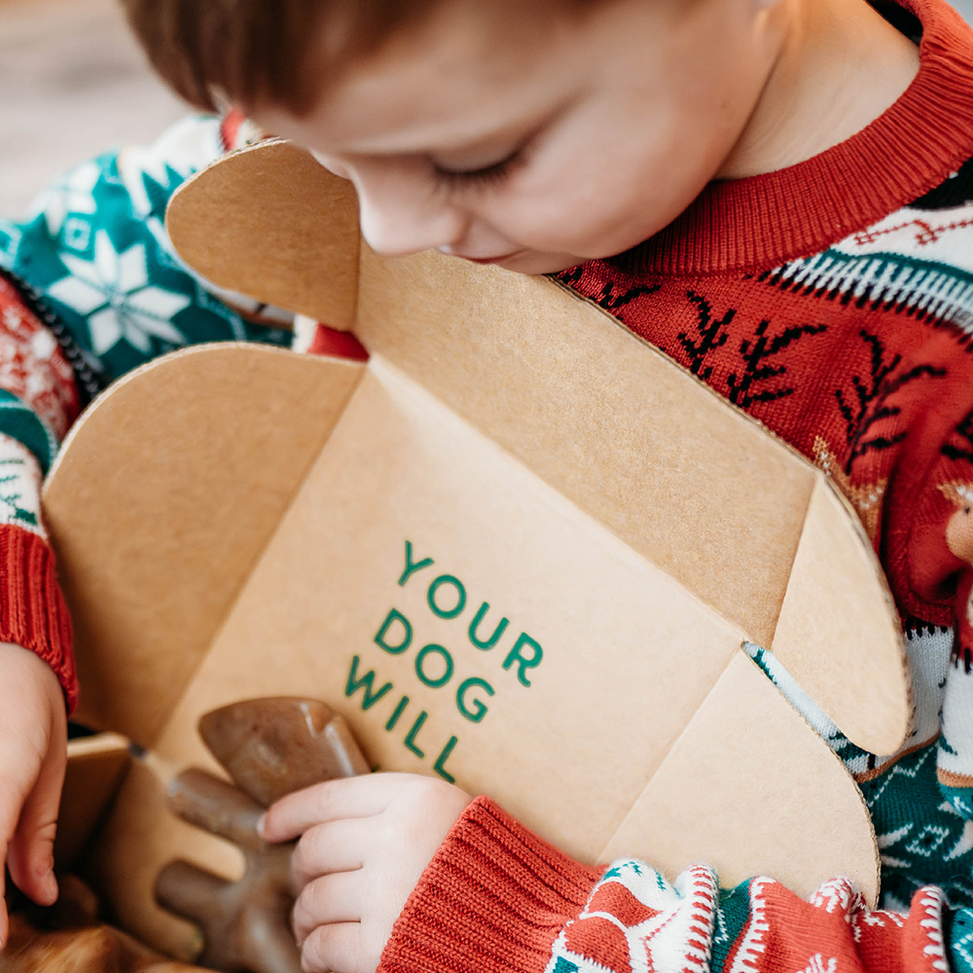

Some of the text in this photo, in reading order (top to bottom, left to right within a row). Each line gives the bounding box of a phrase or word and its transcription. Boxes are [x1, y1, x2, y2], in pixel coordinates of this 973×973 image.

[373, 607, 496, 723] DOG
[397, 540, 544, 688] YOUR
[344, 655, 458, 784] WILL
